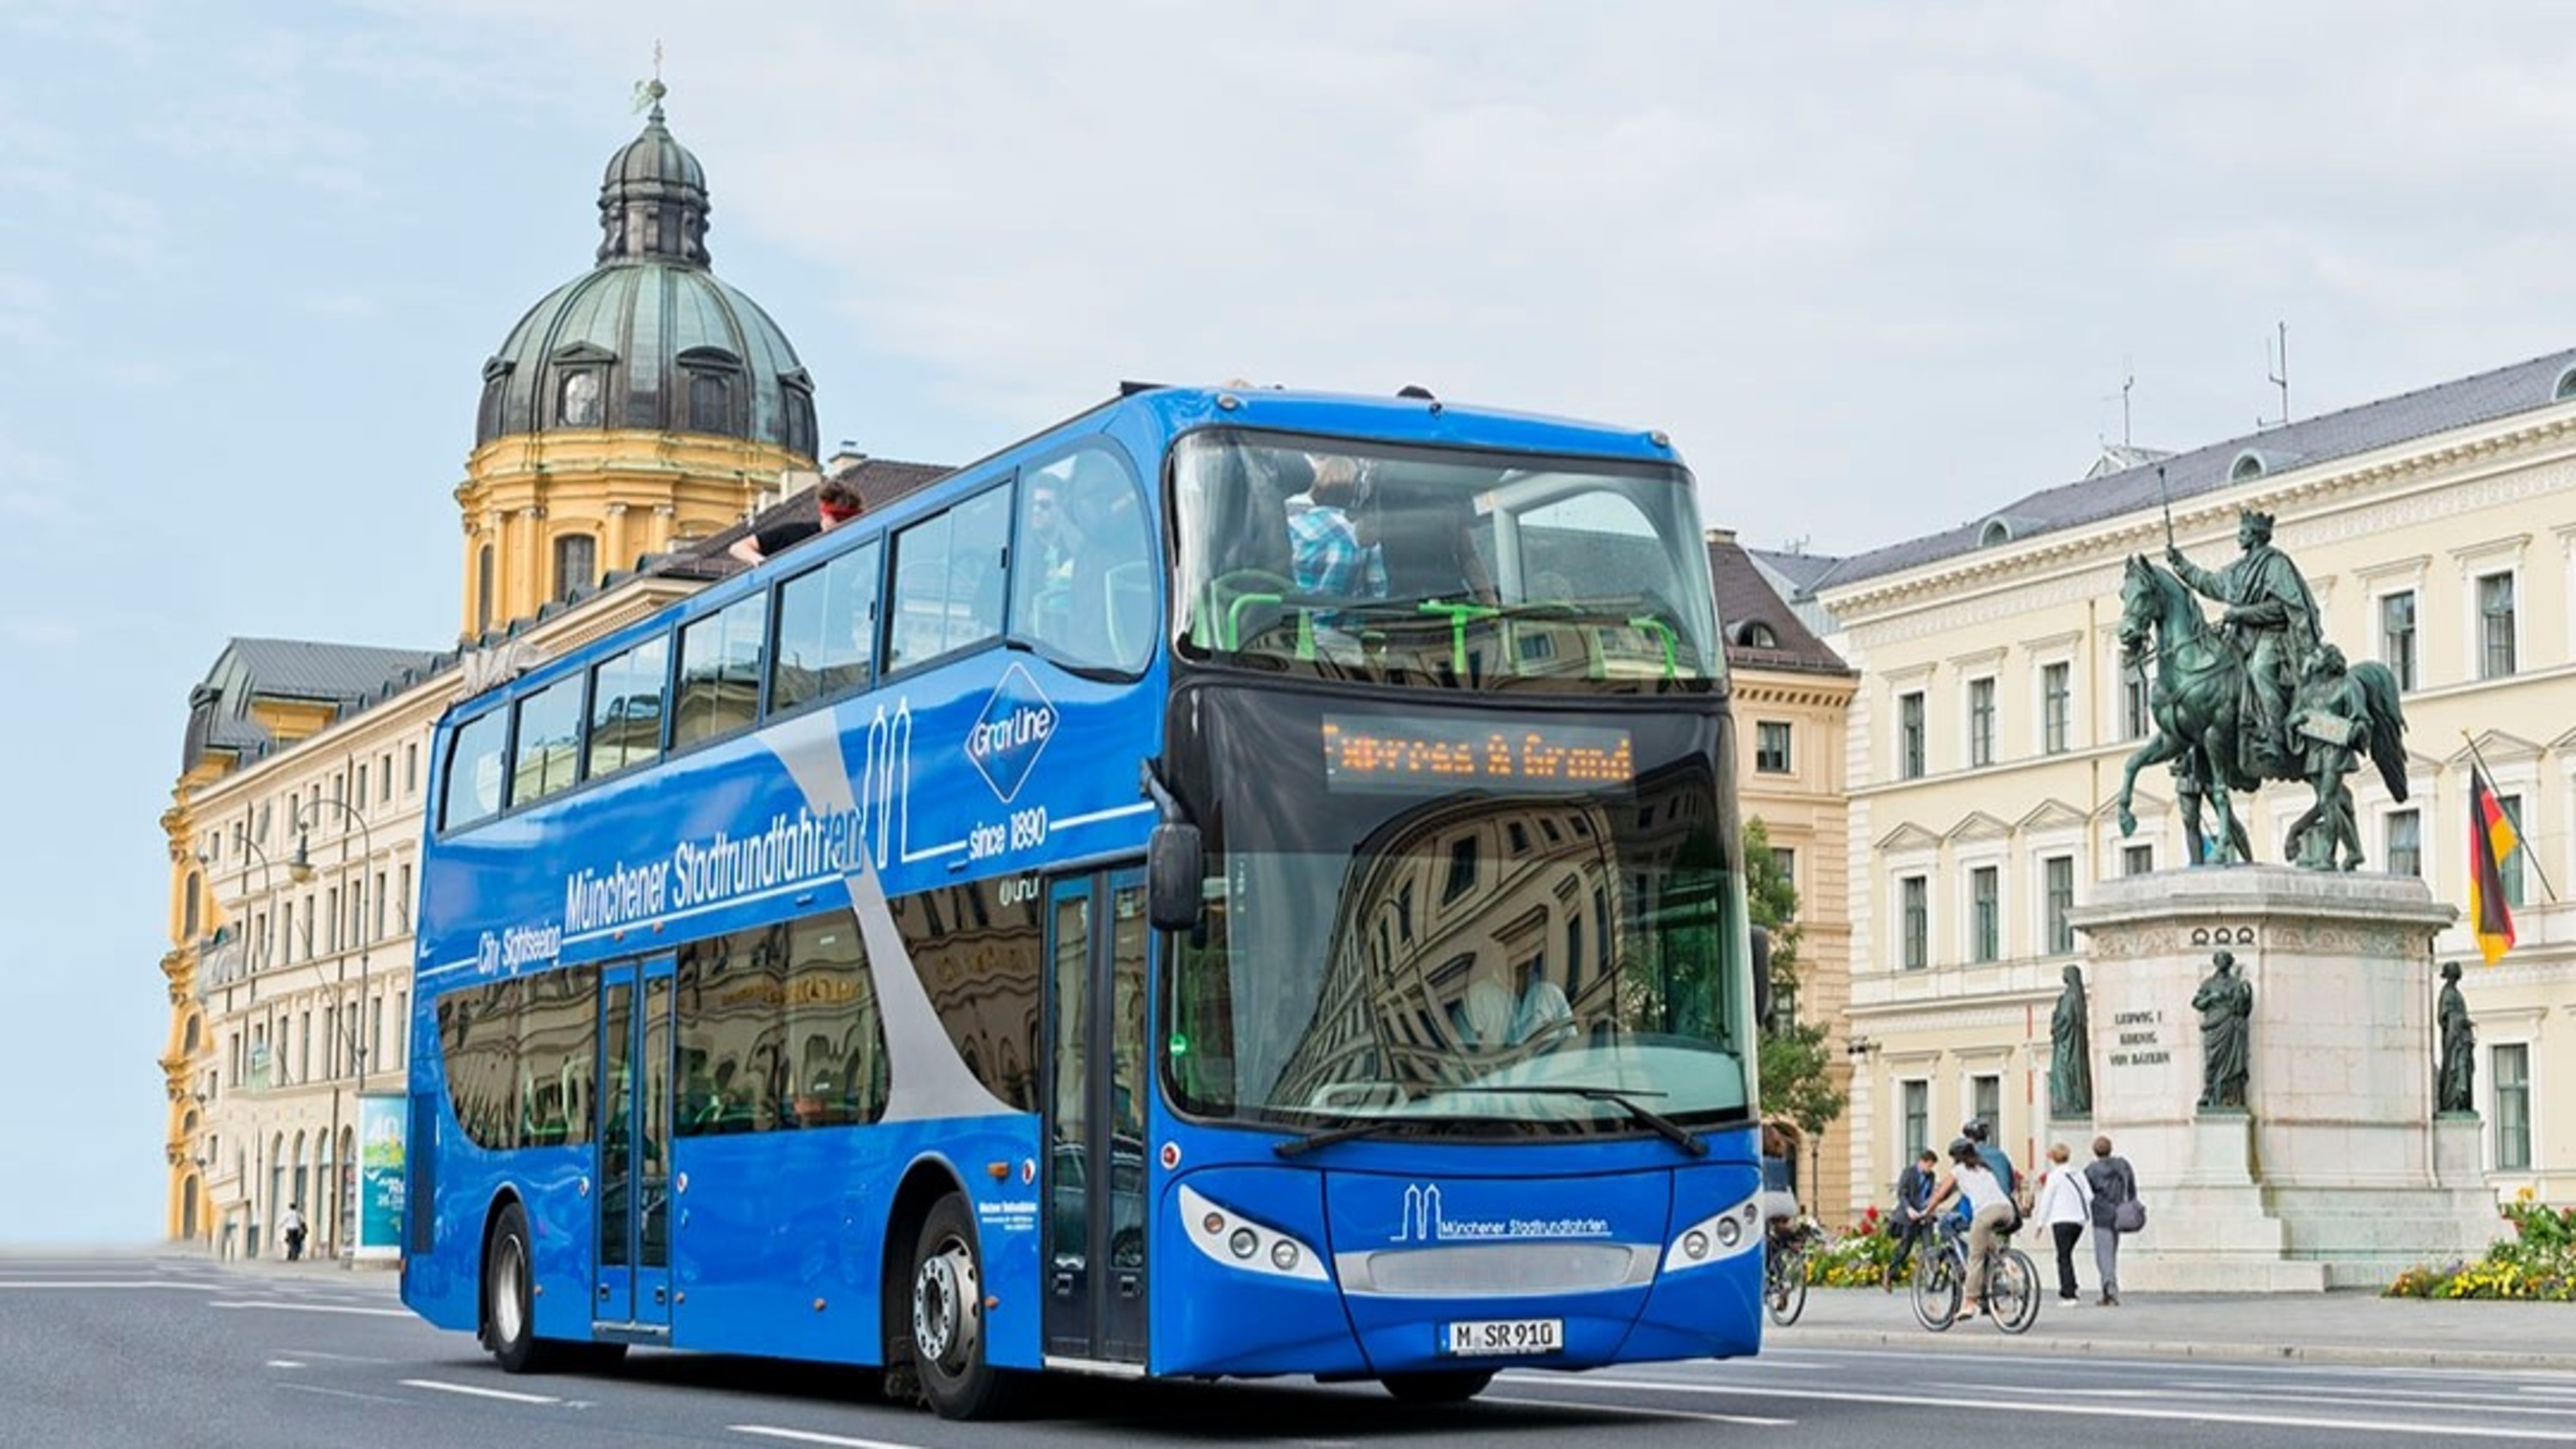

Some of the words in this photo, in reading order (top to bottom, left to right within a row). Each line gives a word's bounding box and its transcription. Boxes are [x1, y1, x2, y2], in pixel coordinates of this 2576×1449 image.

[1523, 732, 1631, 779] Grand
[968, 822, 1005, 860] since
[1011, 806, 1047, 852] 1890
[565, 859, 670, 934] Münchener
[673, 804, 864, 909] Stadtrundfahrten
[1441, 1219, 1505, 1234] Münchener
[1509, 1218, 1608, 1234] Stadtrundfahrten
[1456, 1326, 1470, 1347] M
[1485, 1324, 1510, 1347] SR
[1515, 1322, 1553, 1346] 910
